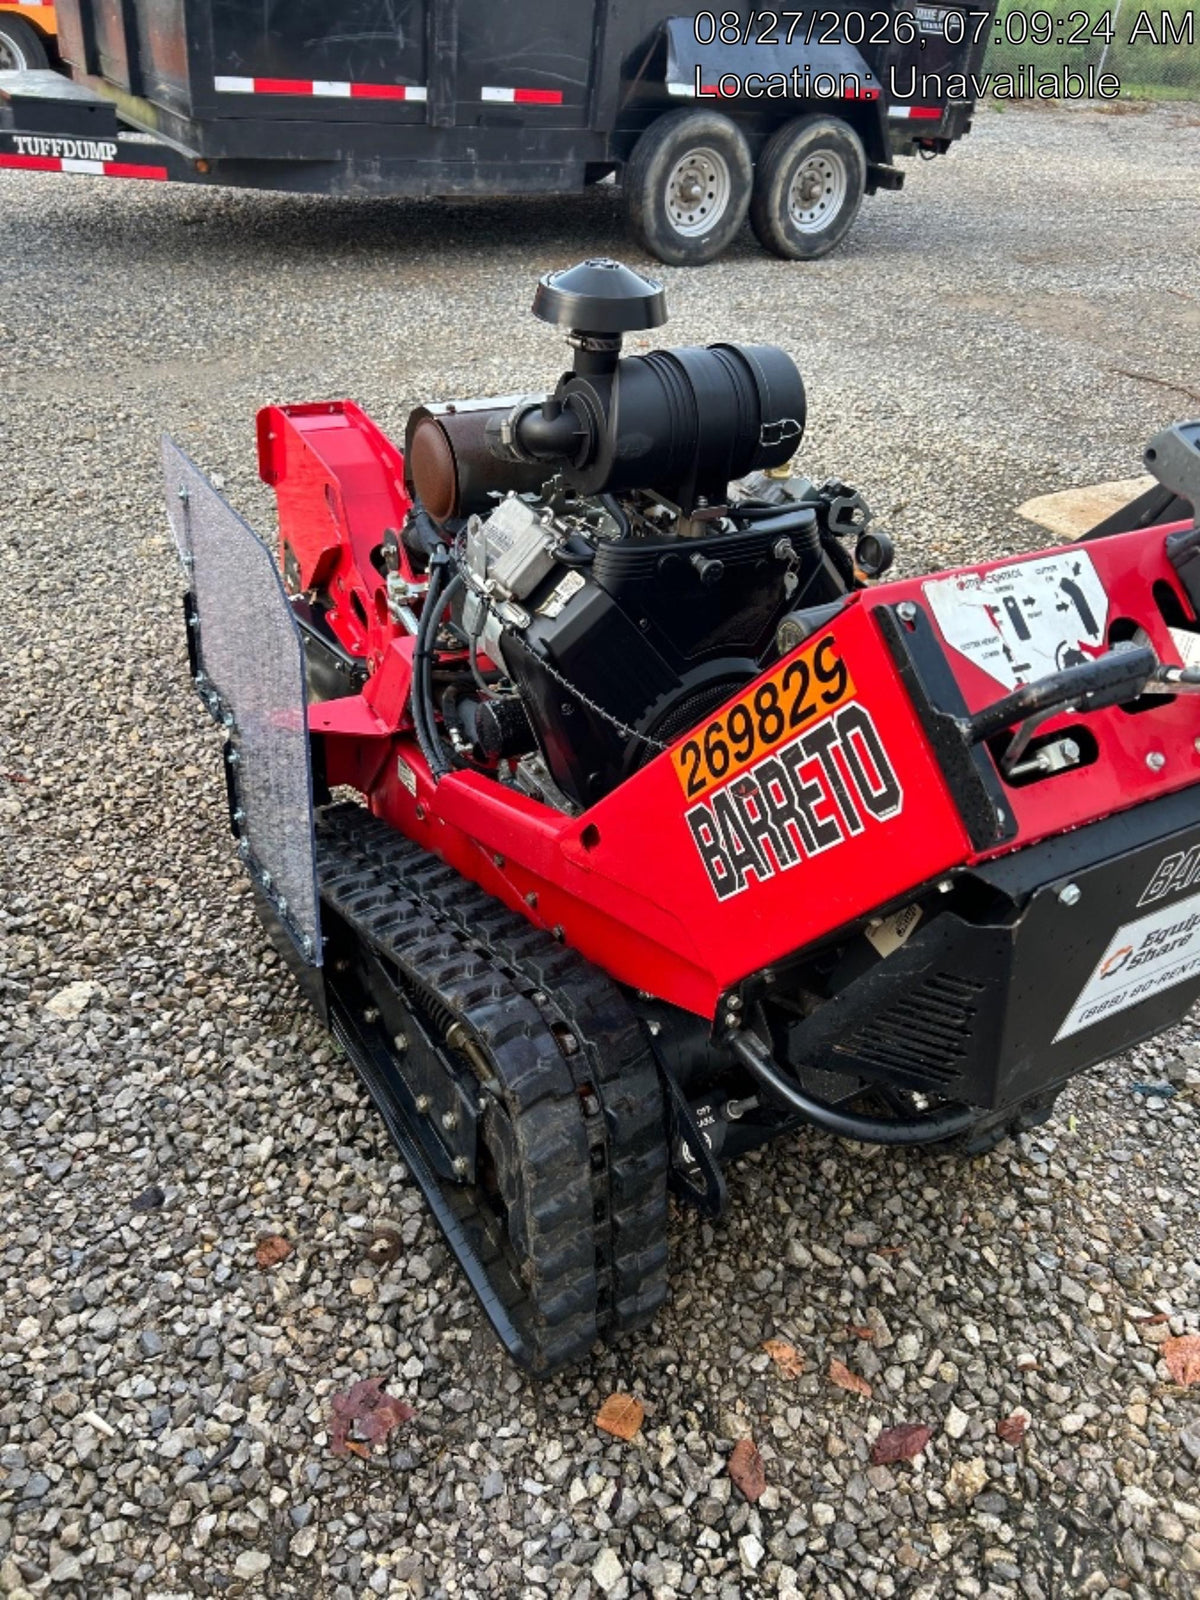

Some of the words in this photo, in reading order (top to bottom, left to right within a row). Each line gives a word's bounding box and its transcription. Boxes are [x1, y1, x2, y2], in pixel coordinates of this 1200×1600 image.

[12, 135, 118, 161] TUFFDUMP
[680, 635, 848, 798] 269829
[684, 700, 903, 902] BARRETO
[1125, 932, 1194, 971] Share
